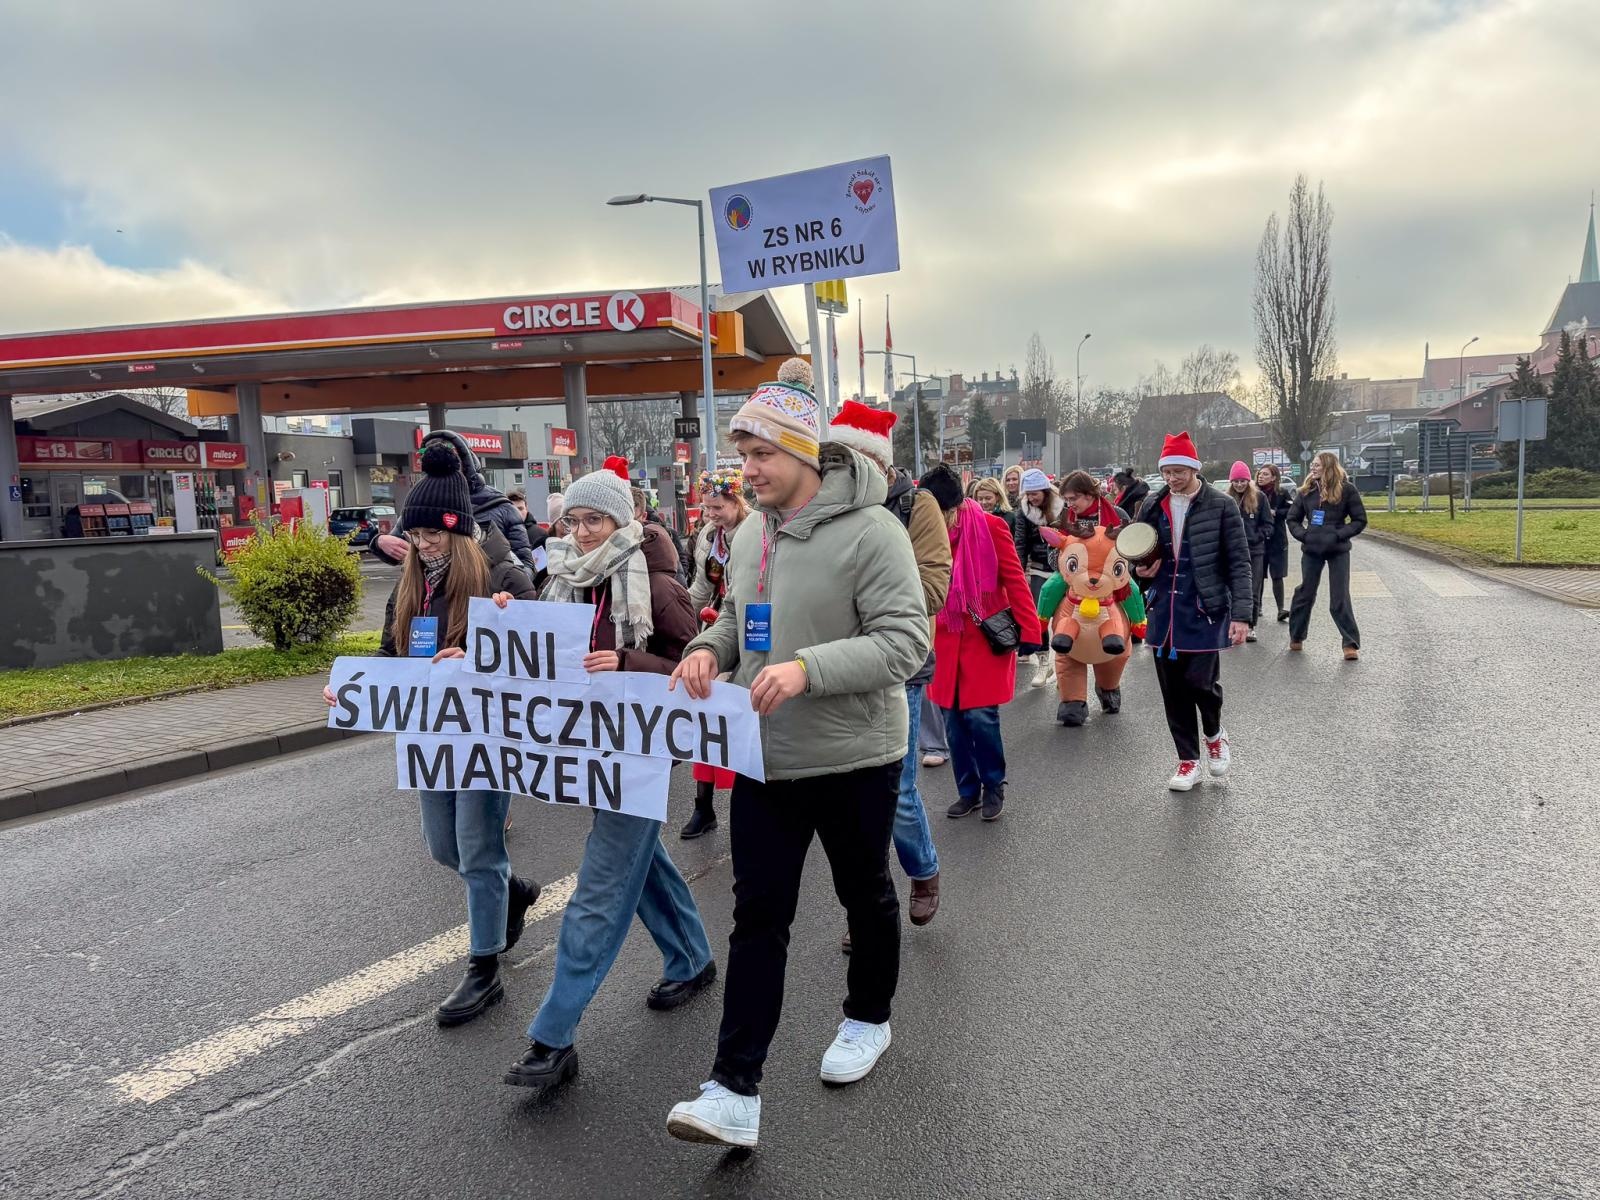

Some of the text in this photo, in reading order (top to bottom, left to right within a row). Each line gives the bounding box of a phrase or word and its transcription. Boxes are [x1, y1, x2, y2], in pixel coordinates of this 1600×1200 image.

[763, 217, 842, 249] ZS NR 6
[747, 243, 865, 279] W RYBNIKU
[503, 297, 643, 330] CIRCLE K
[677, 422, 698, 434] TIR
[50, 443, 67, 458] 13
[147, 445, 197, 461] CIRCLE K
[474, 626, 556, 681] DNI
[335, 671, 729, 768] ŚWIATECZNYCH
[406, 742, 623, 811] MARZEŃ
